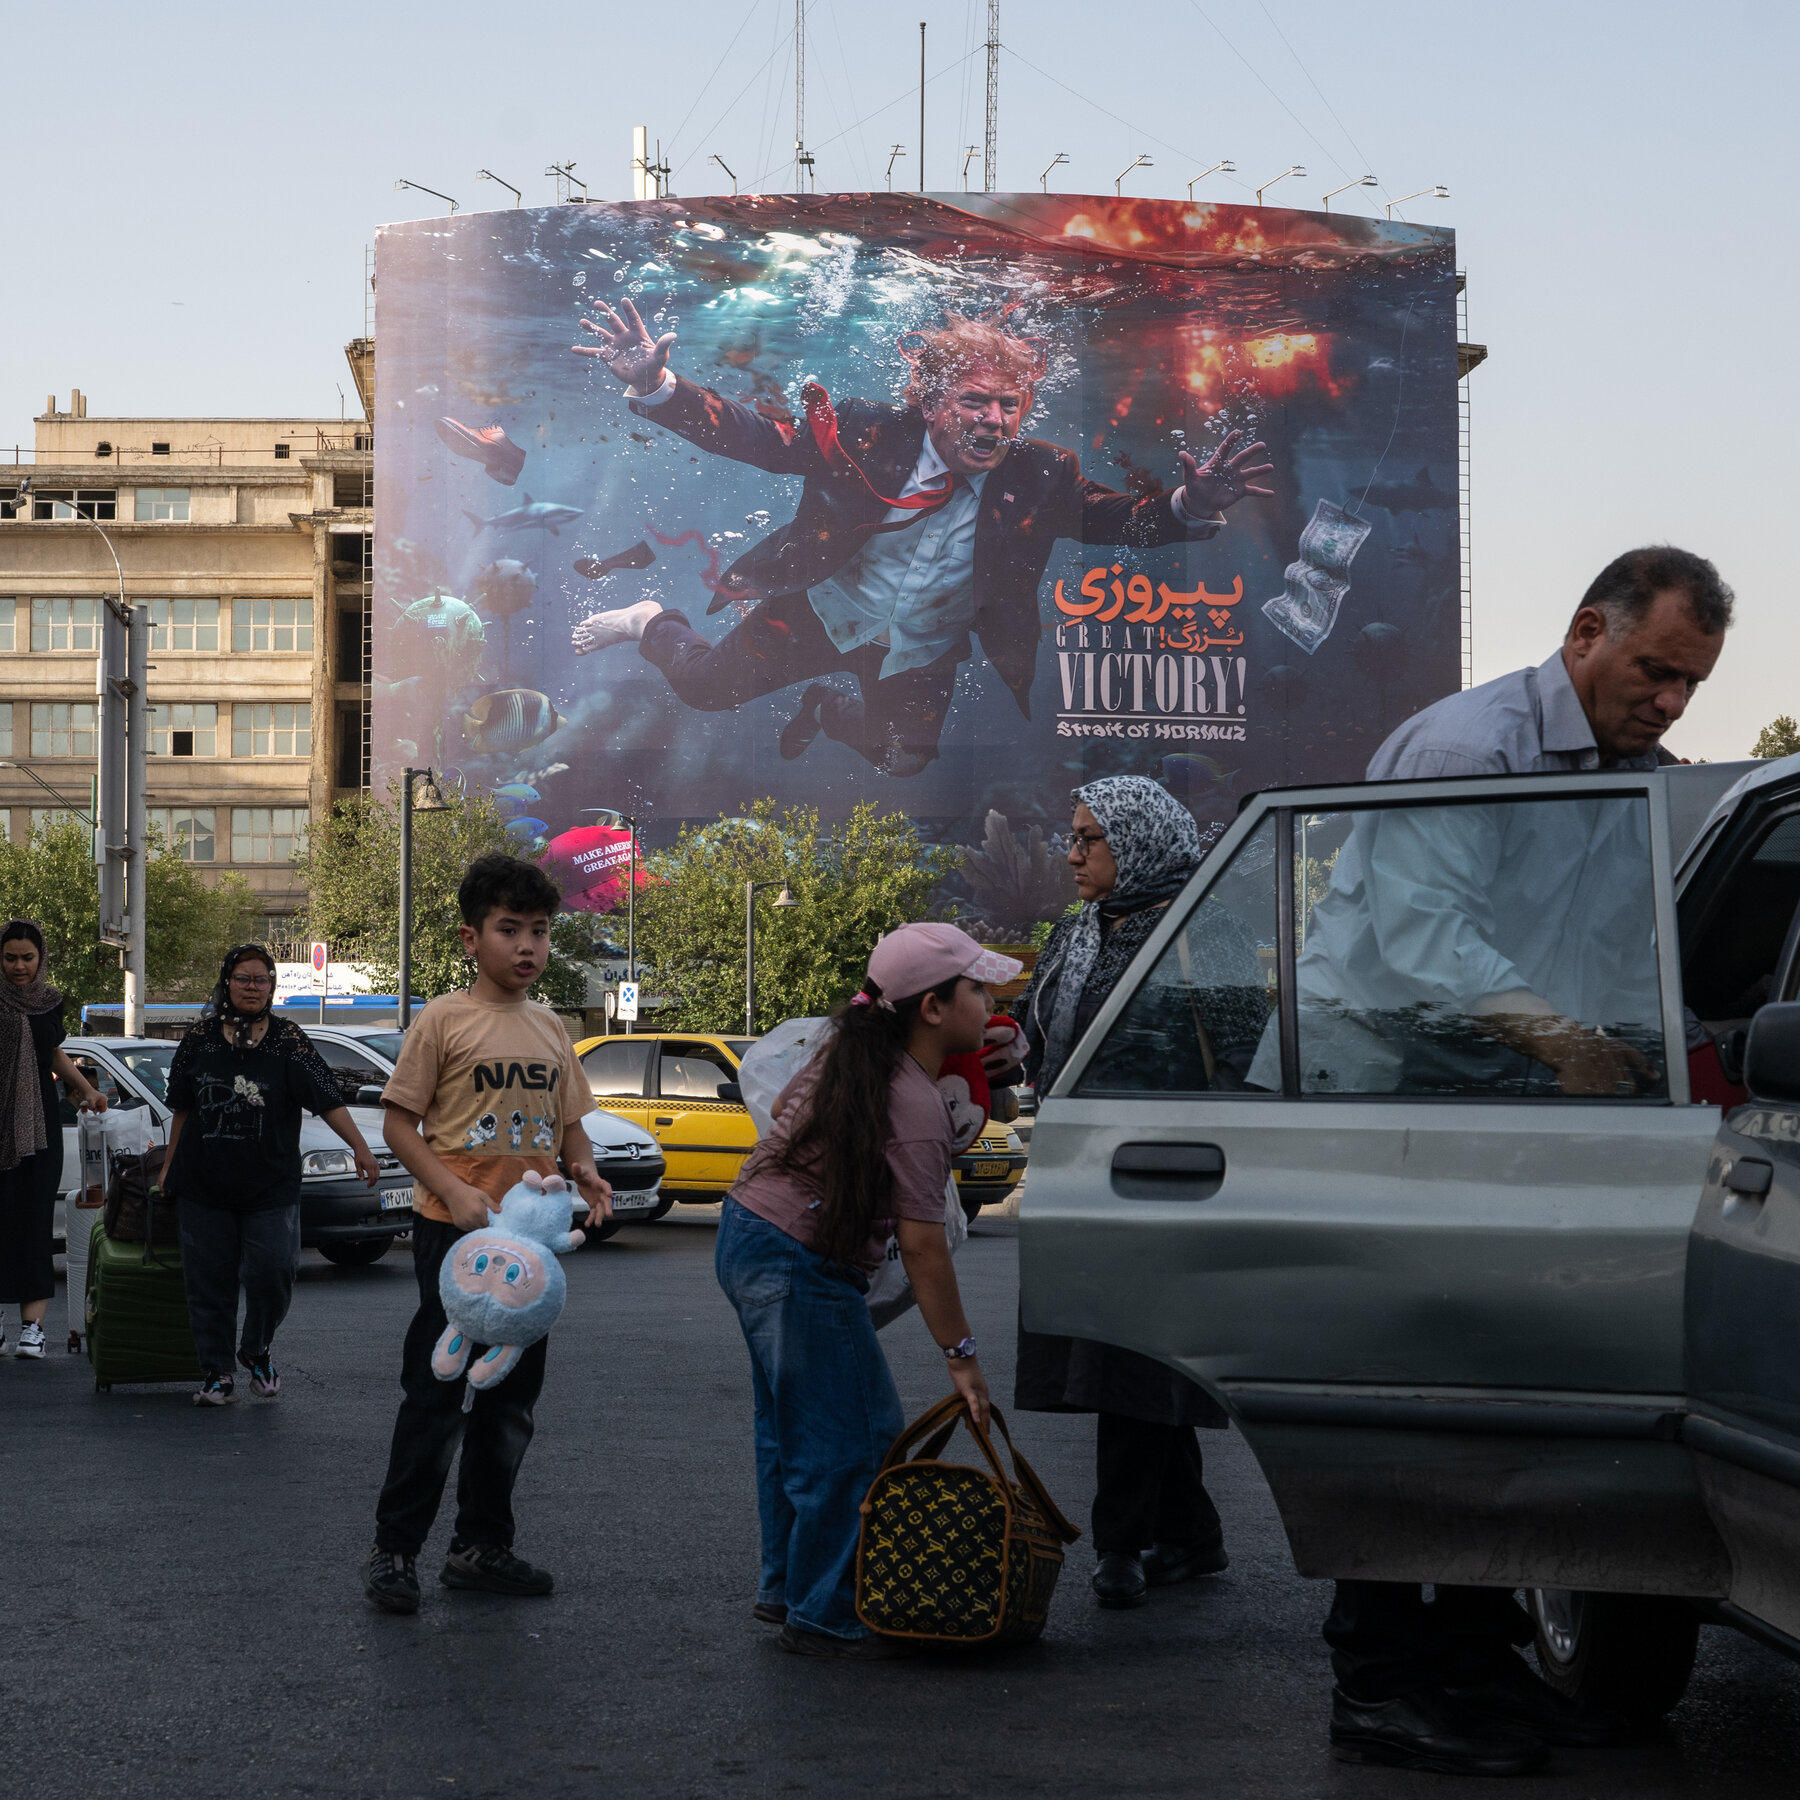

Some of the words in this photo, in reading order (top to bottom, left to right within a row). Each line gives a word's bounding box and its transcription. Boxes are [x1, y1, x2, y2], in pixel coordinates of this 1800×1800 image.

[1056, 624, 1155, 649] GREAT
[1056, 652, 1247, 715] VICTORY!
[572, 848, 604, 865] MAKE
[583, 855, 617, 874] GREAT
[474, 1062, 559, 1092] NASA
